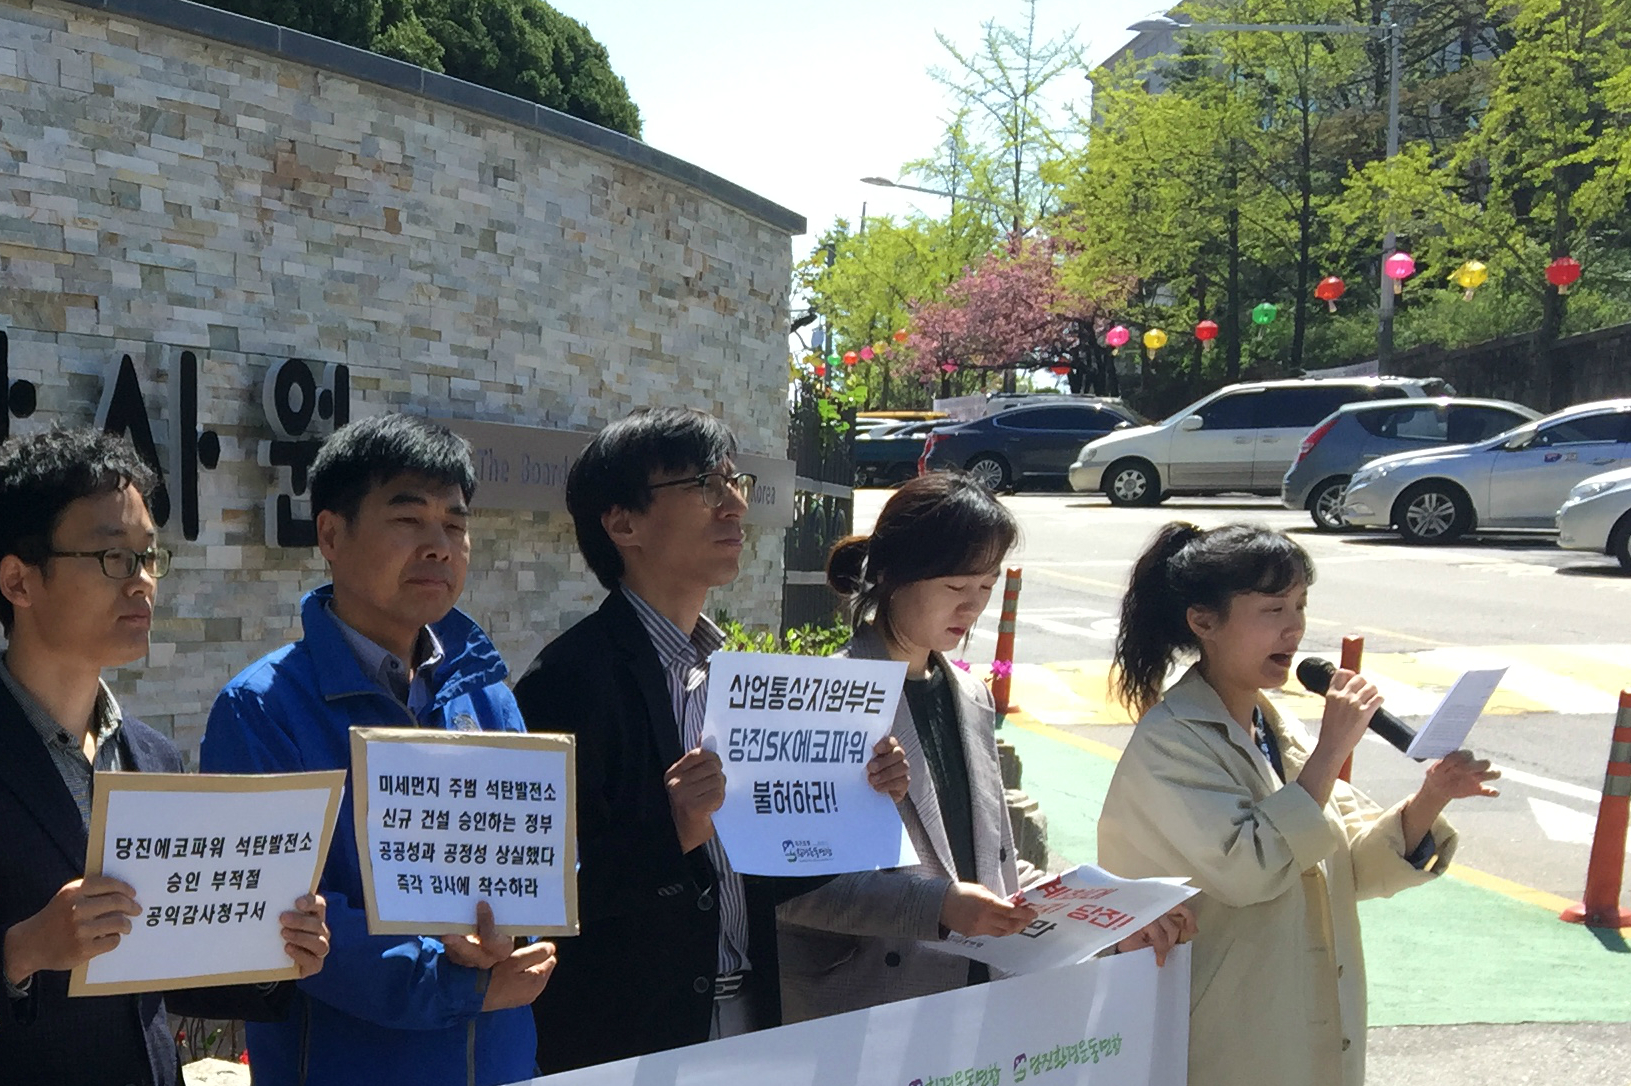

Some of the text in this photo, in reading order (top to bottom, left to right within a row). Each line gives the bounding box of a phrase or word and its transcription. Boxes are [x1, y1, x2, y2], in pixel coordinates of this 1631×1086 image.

[477, 448, 569, 486] The Board
[729, 675, 885, 714] 산업통상자원부는
[729, 728, 867, 763] 당진SK에코파워
[379, 775, 556, 801] 미세먼지 주범 석탄발전소
[753, 780, 838, 814] 불허하라!
[383, 808, 552, 834] 신규 건설 승인하는 정부
[116, 832, 312, 860] 당진에코파워 석탄발전소
[380, 841, 555, 866] 공공성과 공정성 상실했다
[167, 869, 260, 893] 승인 부적절
[397, 874, 538, 898] 즉각 감사에 착수하라
[147, 901, 266, 927] 공익감사청구서
[1067, 904, 1136, 931] 당진!
[1030, 1033, 1123, 1076] 당진환경운동연합
